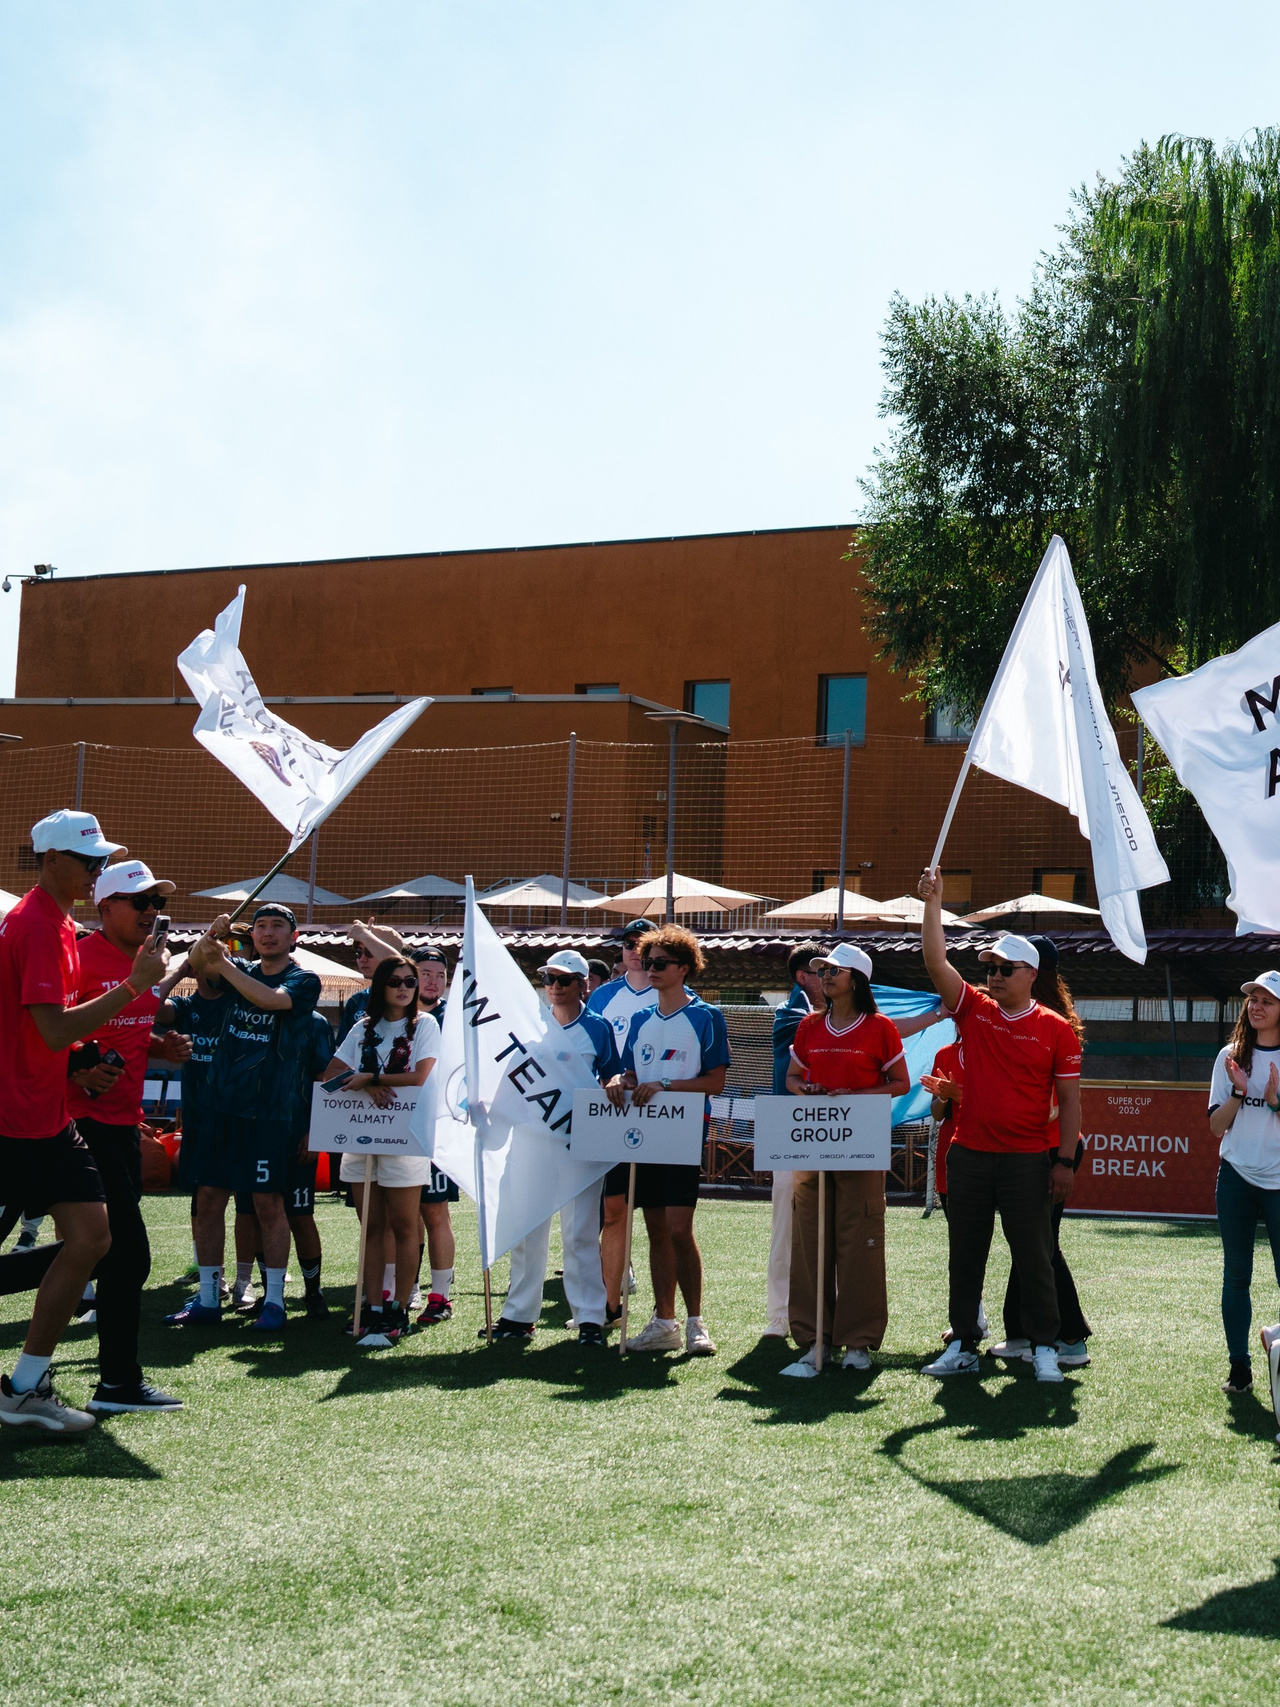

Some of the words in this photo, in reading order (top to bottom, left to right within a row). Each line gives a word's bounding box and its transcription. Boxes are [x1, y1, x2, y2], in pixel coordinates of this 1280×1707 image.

[1108, 779, 1138, 852] JAECOO
[191, 1053, 213, 1062] SUB
[323, 1099, 365, 1110] TOYOTA
[1107, 1096, 1132, 1106] SUPER
[1134, 1097, 1152, 1106] CUP
[1241, 1096, 1266, 1110] car
[588, 1103, 631, 1118] BMW
[637, 1104, 685, 1119] TEAM
[792, 1107, 851, 1122] CHERY
[1118, 1106, 1140, 1115] 2026
[349, 1114, 395, 1125] ALMATY
[374, 1137, 408, 1145] SUBARU
[790, 1128, 853, 1142] GROUP
[1082, 1134, 1189, 1154] YDRATION
[256, 1160, 270, 1183] 5
[1091, 1158, 1166, 1178] BREAK
[293, 1187, 310, 1208] 11
